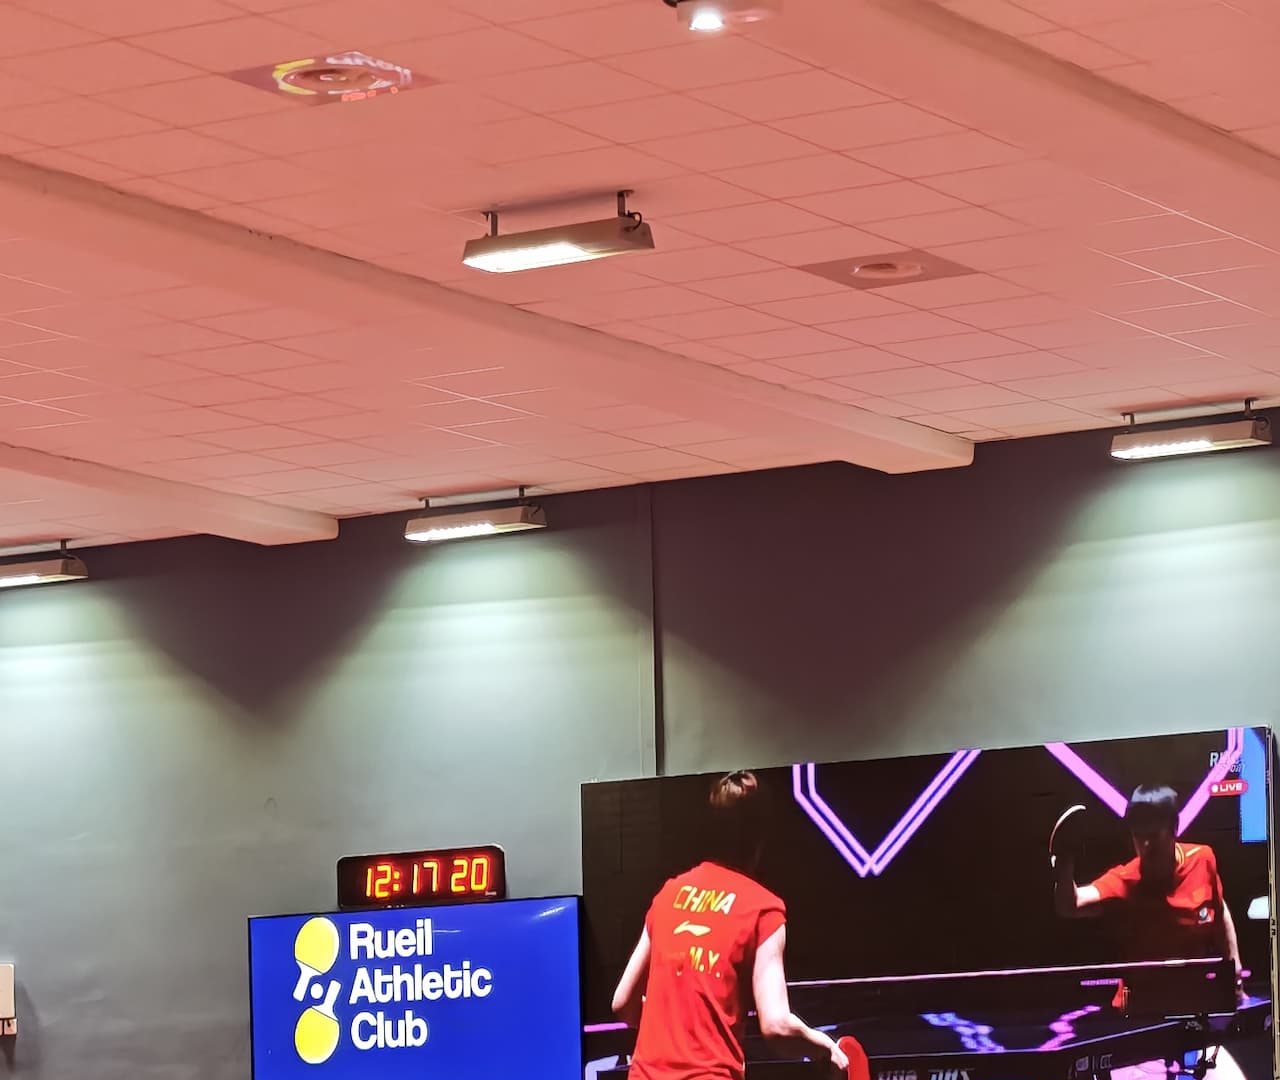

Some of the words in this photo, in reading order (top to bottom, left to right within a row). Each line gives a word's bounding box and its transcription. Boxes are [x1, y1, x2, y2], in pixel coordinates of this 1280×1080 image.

[1220, 783, 1243, 792] LIVE
[366, 861, 439, 898] 12:17
[450, 857, 489, 892] 20
[673, 885, 737, 914] CHINA
[349, 918, 433, 960] Rueil
[348, 960, 493, 1005] Athletic
[350, 1009, 429, 1051] Club
